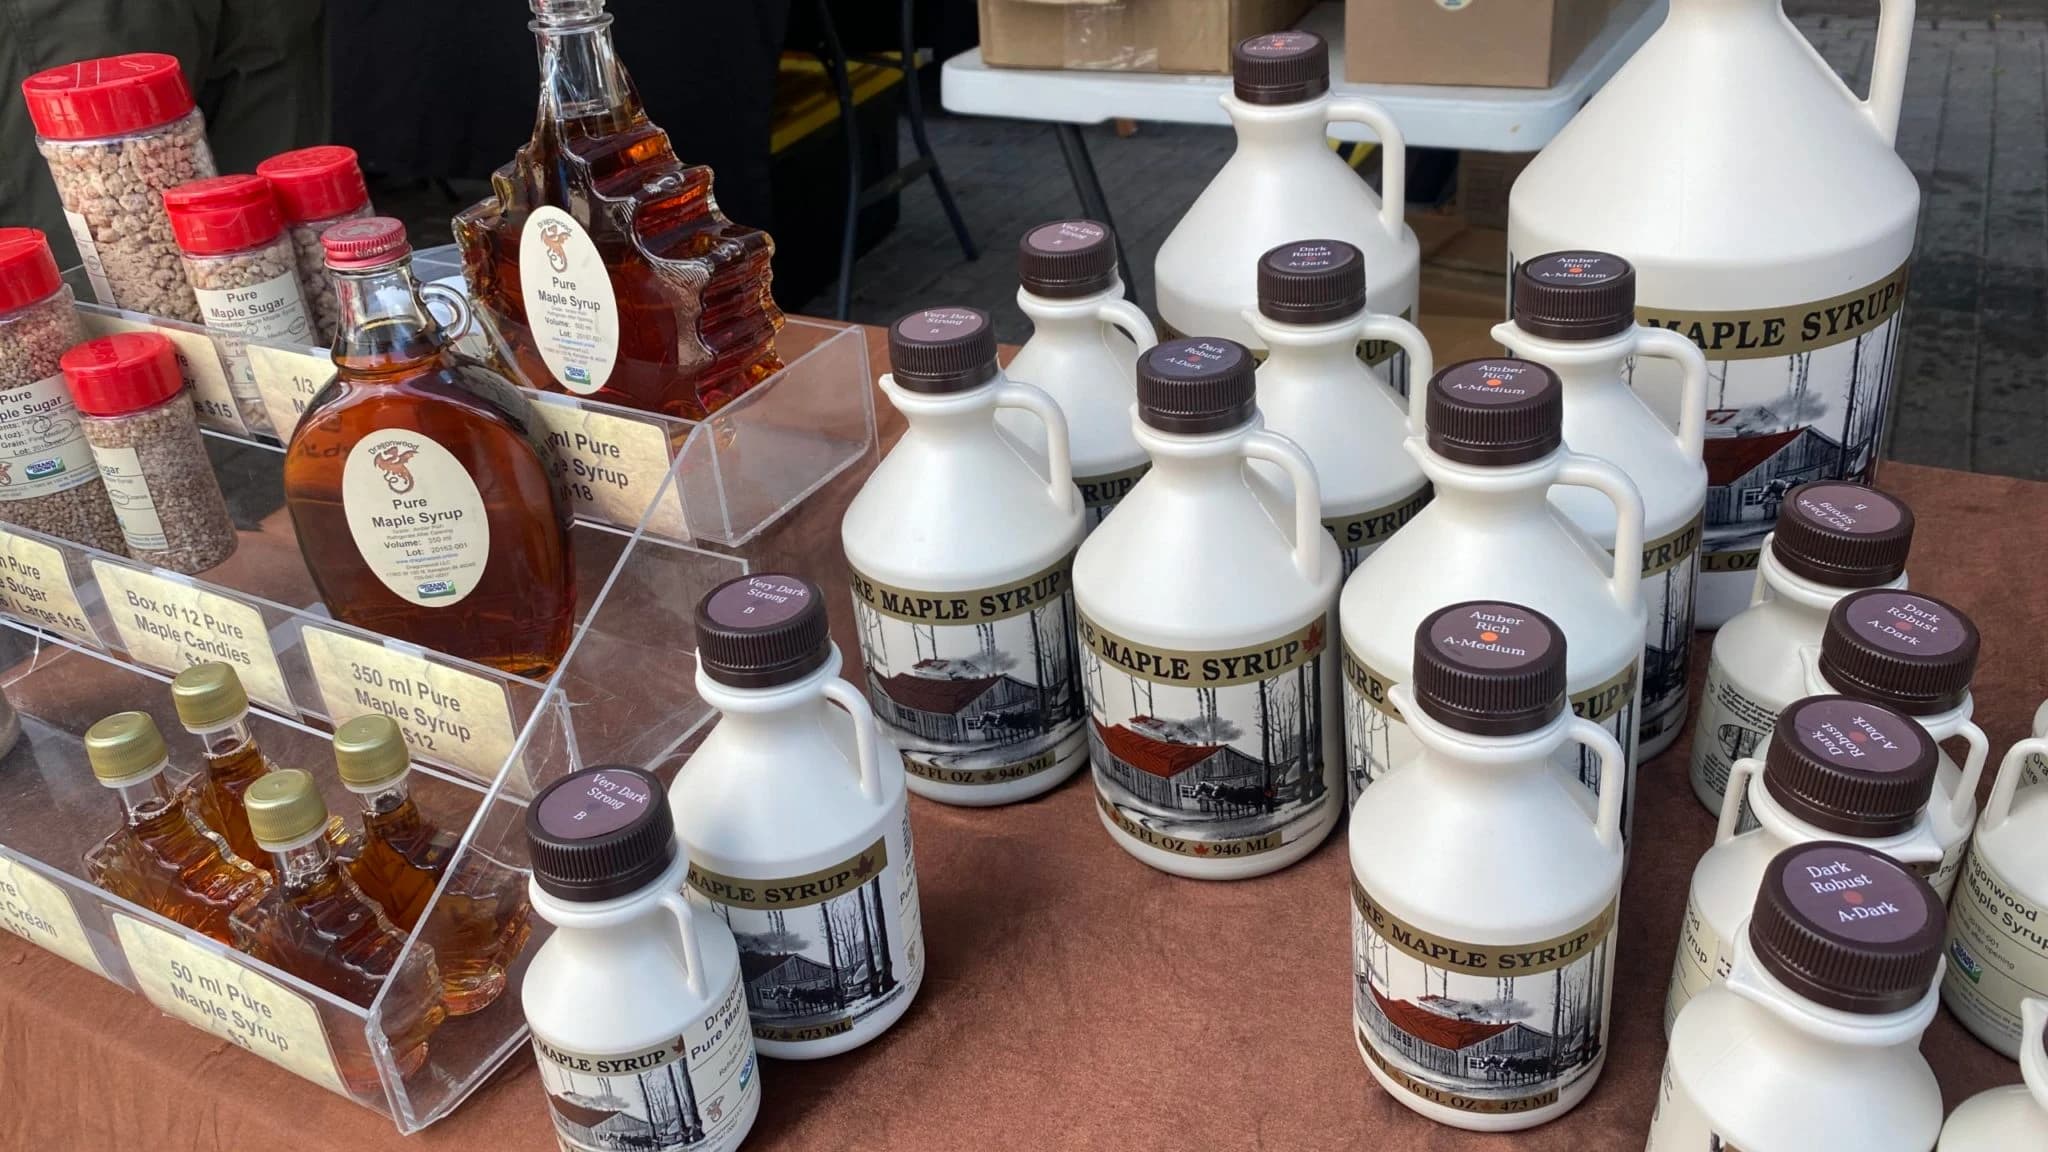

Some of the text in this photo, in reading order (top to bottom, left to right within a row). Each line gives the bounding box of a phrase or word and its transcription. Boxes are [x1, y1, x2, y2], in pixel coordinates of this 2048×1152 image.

[1556, 256, 1602, 264] Amber
[552, 276, 577, 291] Pure
[1541, 271, 1607, 279] A-Medium
[226, 290, 258, 303] Pure
[538, 290, 601, 312] Maple Syrup
[210, 297, 286, 321] Maple Sugar
[1801, 281, 1897, 343] SYRUP
[1184, 346, 1222, 361] Robust
[1198, 342, 1226, 355] Dark
[1164, 356, 1203, 370] A-Dark
[1477, 363, 1528, 375] Amber
[292, 375, 316, 394] 1/3
[1482, 371, 1514, 381] Rich
[0, 391, 33, 406] Pure
[1451, 382, 1526, 396] A-Medium
[0, 409, 20, 422] ple
[22, 395, 63, 413] Sugar
[205, 401, 234, 420] $15
[367, 440, 420, 454] Dragonwood
[575, 433, 621, 459] Pure
[573, 458, 630, 490] Syrup
[561, 482, 595, 502] 18
[1078, 477, 1132, 502] RUP
[391, 497, 428, 511] Pure
[1799, 499, 1827, 517] Dark
[1819, 502, 1857, 525] Strong
[371, 507, 464, 528] Maple Syrup
[384, 540, 422, 549] Volume:
[406, 549, 425, 557] Lot:
[1641, 527, 1695, 572] YRUP
[8, 556, 41, 580] Pure
[6, 576, 48, 602] Sugar
[746, 588, 789, 604] Strong
[747, 577, 807, 598] Very Dark
[853, 570, 1061, 620] RE MAPLE SYRUP
[15, 599, 87, 632] Large $15
[126, 589, 244, 640] Box of 12 Pure
[743, 606, 755, 614] B
[1469, 609, 1525, 627] Amber
[1886, 606, 1939, 634] Robust
[1903, 603, 1941, 625] Dark
[134, 613, 252, 666] Maple Candies
[1475, 620, 1511, 635] Rich
[1865, 619, 1921, 646] A-Dark
[1100, 634, 1192, 682] MAPLE
[1201, 639, 1301, 682] SYRUP
[1443, 636, 1527, 657] A-Medium
[351, 661, 462, 713] 350 ml Pure
[353, 687, 472, 743] Maple Syrup
[401, 727, 438, 752] $12
[1811, 729, 1845, 756] Dark
[1821, 721, 1867, 758] Robust
[1852, 715, 1899, 750] A-Dark
[910, 763, 925, 777] 32
[926, 765, 949, 782] FL
[950, 769, 976, 784] OZ
[998, 763, 1025, 779] 946
[586, 786, 626, 810] Strong
[592, 772, 648, 804] Very Dark
[572, 810, 588, 821] B
[1122, 818, 1275, 856] 32 FL OZ 946 ML
[1805, 859, 1852, 879] Dark
[0, 880, 16, 896] re
[763, 870, 851, 904] SYRUP
[1809, 873, 1874, 894] Robust
[1967, 871, 1999, 916] Maple
[1969, 849, 2039, 923] ragonwood
[6, 900, 59, 938] Cream
[1837, 901, 1901, 923] A-Dark
[1390, 923, 1488, 970] MAPLE
[1497, 932, 1592, 970] SYRUP
[170, 960, 273, 1019] 50 ml Pure
[170, 982, 290, 1053] Maple Syrup
[796, 1026, 823, 1042] 473
[826, 1018, 852, 1039] ML
[691, 1029, 723, 1061] Pure
[539, 1043, 668, 1075] MAPLE SYRUP
[1405, 1079, 1421, 1094] 16
[1423, 1086, 1448, 1105] FL
[1451, 1093, 1479, 1111] OZ
[1500, 1094, 1529, 1112] 473
